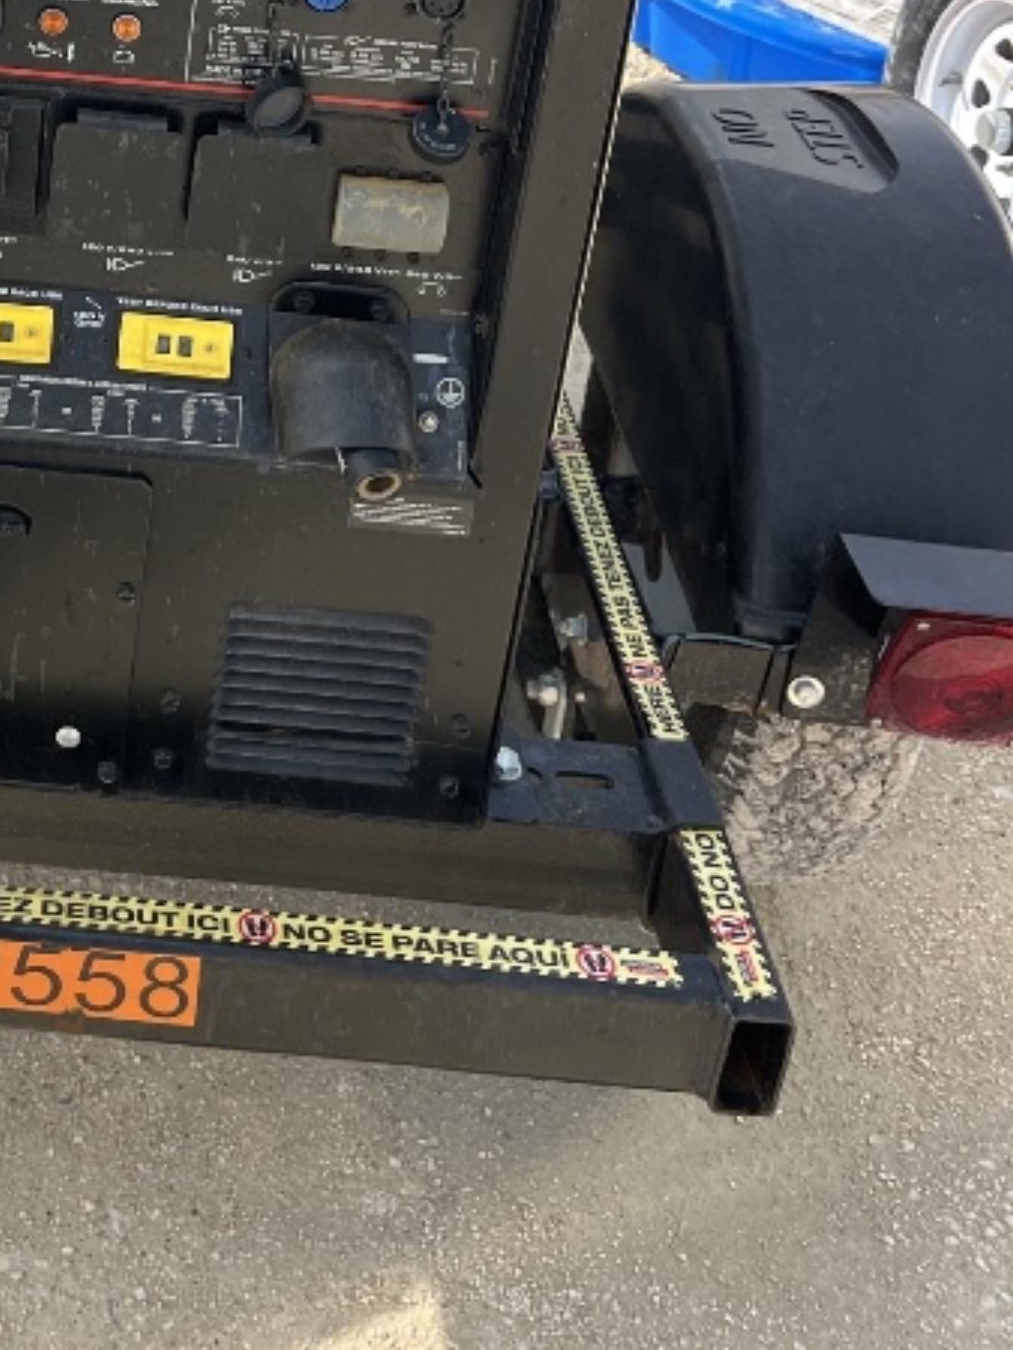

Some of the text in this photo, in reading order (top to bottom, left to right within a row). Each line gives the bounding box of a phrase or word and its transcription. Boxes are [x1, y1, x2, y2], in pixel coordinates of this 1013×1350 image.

[709, 874, 735, 910] DO
[40, 899, 185, 930] DEBOUT
[187, 912, 231, 934] ICI
[282, 922, 332, 944] NO
[340, 929, 385, 950] SE
[391, 933, 481, 958] PARE
